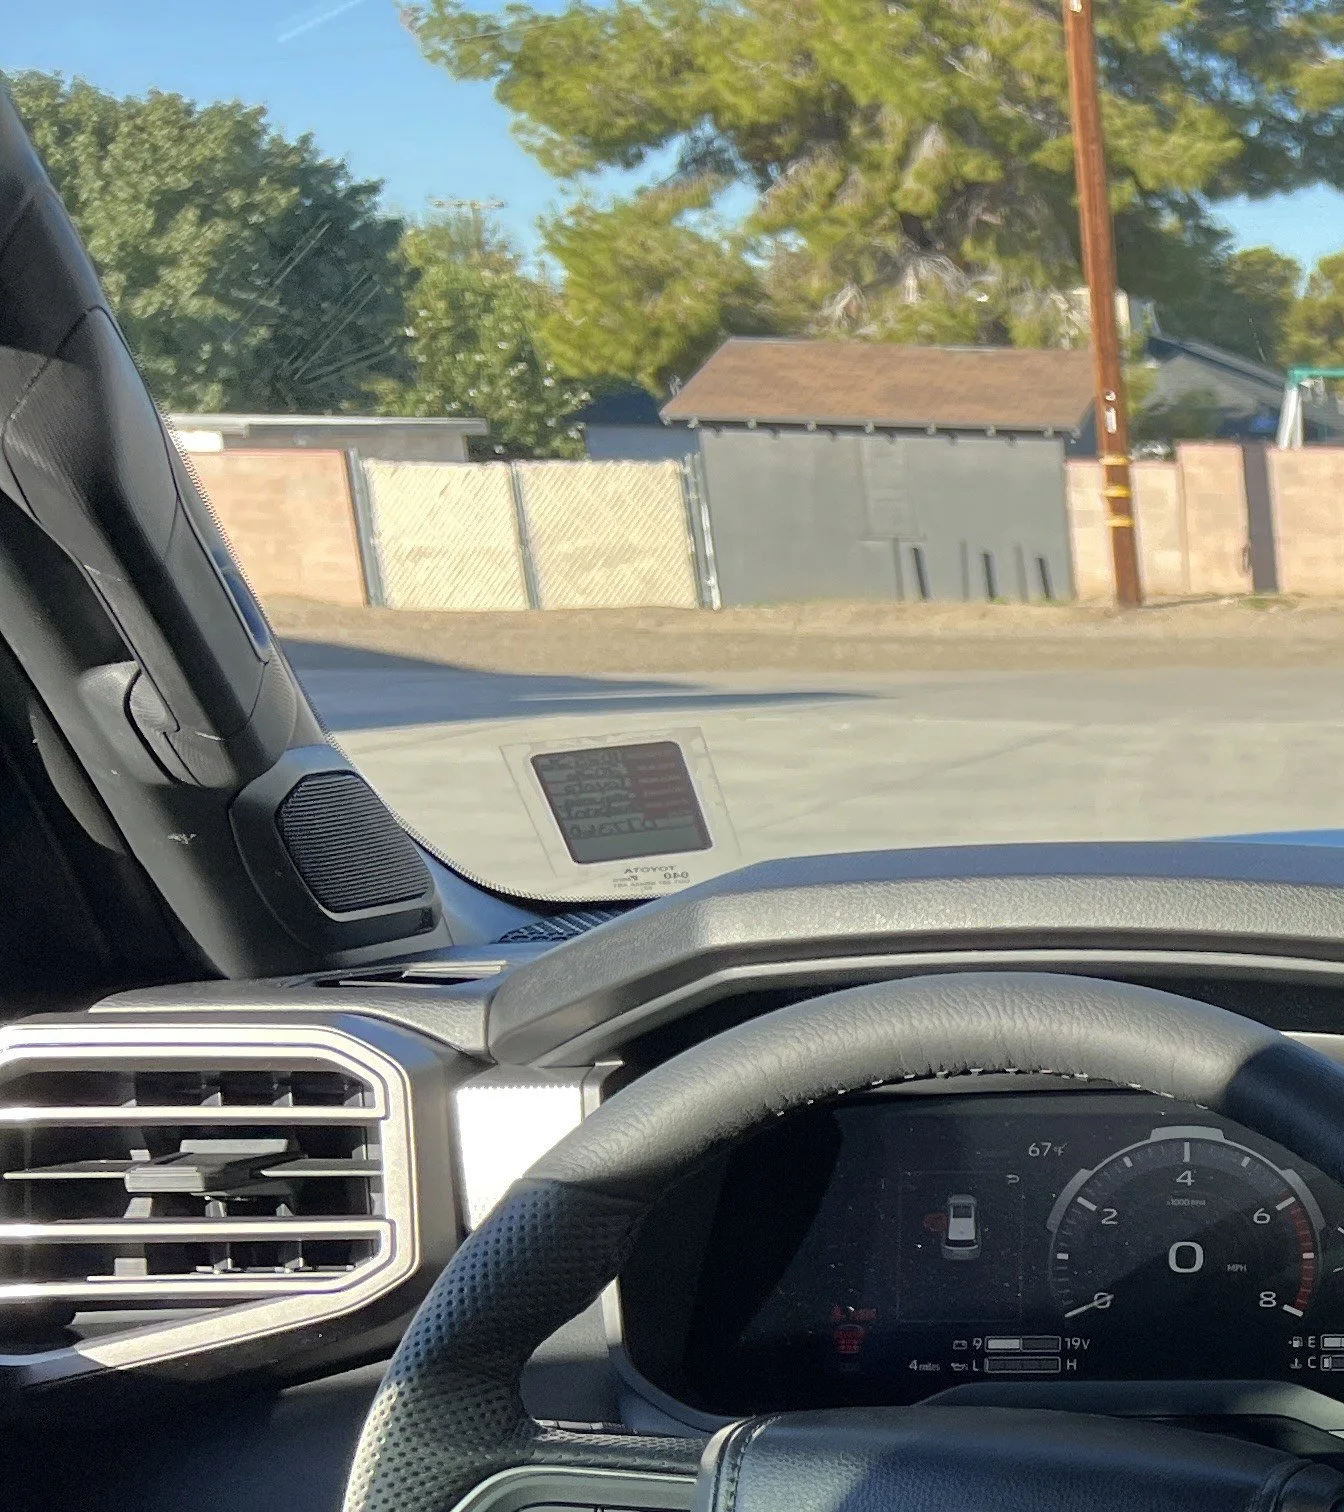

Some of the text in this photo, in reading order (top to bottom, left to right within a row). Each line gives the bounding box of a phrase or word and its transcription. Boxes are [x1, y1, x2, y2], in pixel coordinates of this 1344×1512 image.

[1176, 1169, 1195, 1187] 4
[1101, 1207, 1118, 1225] 2
[1252, 1207, 1271, 1225] 6
[1168, 1241, 1204, 1274] 0
[1226, 1263, 1248, 1273] MPH
[1258, 1290, 1277, 1308] 8
[972, 1337, 983, 1350] 9
[1064, 1337, 1091, 1350] 19V
[1307, 1336, 1316, 1348] E
[908, 1359, 918, 1371] 4
[972, 1359, 979, 1372] L
[1066, 1358, 1078, 1371] H
[1307, 1355, 1317, 1368] C
